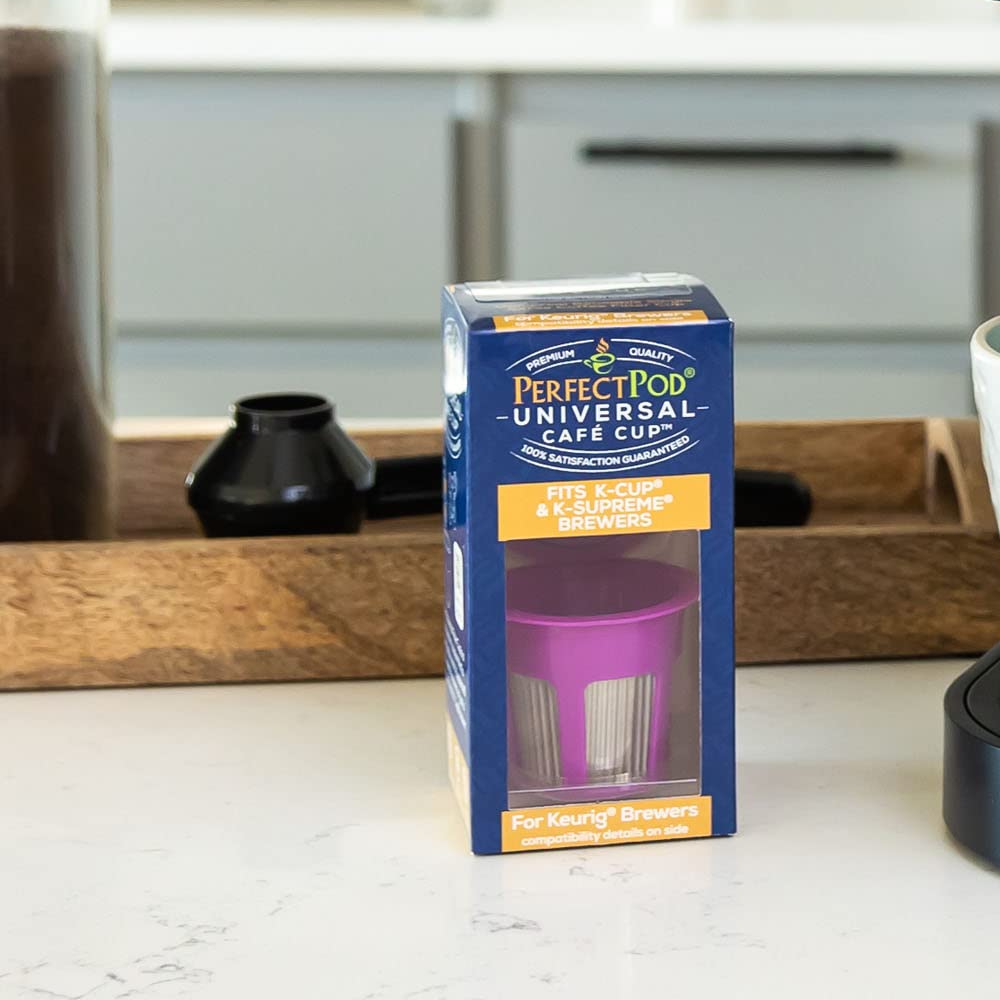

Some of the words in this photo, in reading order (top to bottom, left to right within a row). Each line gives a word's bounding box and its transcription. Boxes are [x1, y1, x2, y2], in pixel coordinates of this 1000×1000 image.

[525, 350, 575, 372] PREMIUM
[629, 347, 674, 363] QUALITY
[513, 400, 696, 426] UNIVERSAL
[542, 425, 603, 444] CAFÉ
[521, 444, 547, 460] 100%
[548, 453, 621, 467] SATISFACTION
[622, 435, 690, 464] GUARANTEED
[547, 485, 586, 500] FITS
[536, 503, 548, 517] &
[558, 513, 652, 531] BREWERS
[511, 814, 544, 830] For
[621, 805, 699, 822] Brewers
[521, 830, 601, 847] compatibility
[603, 827, 645, 840] details
[646, 827, 662, 837] on
[663, 824, 689, 836] side
